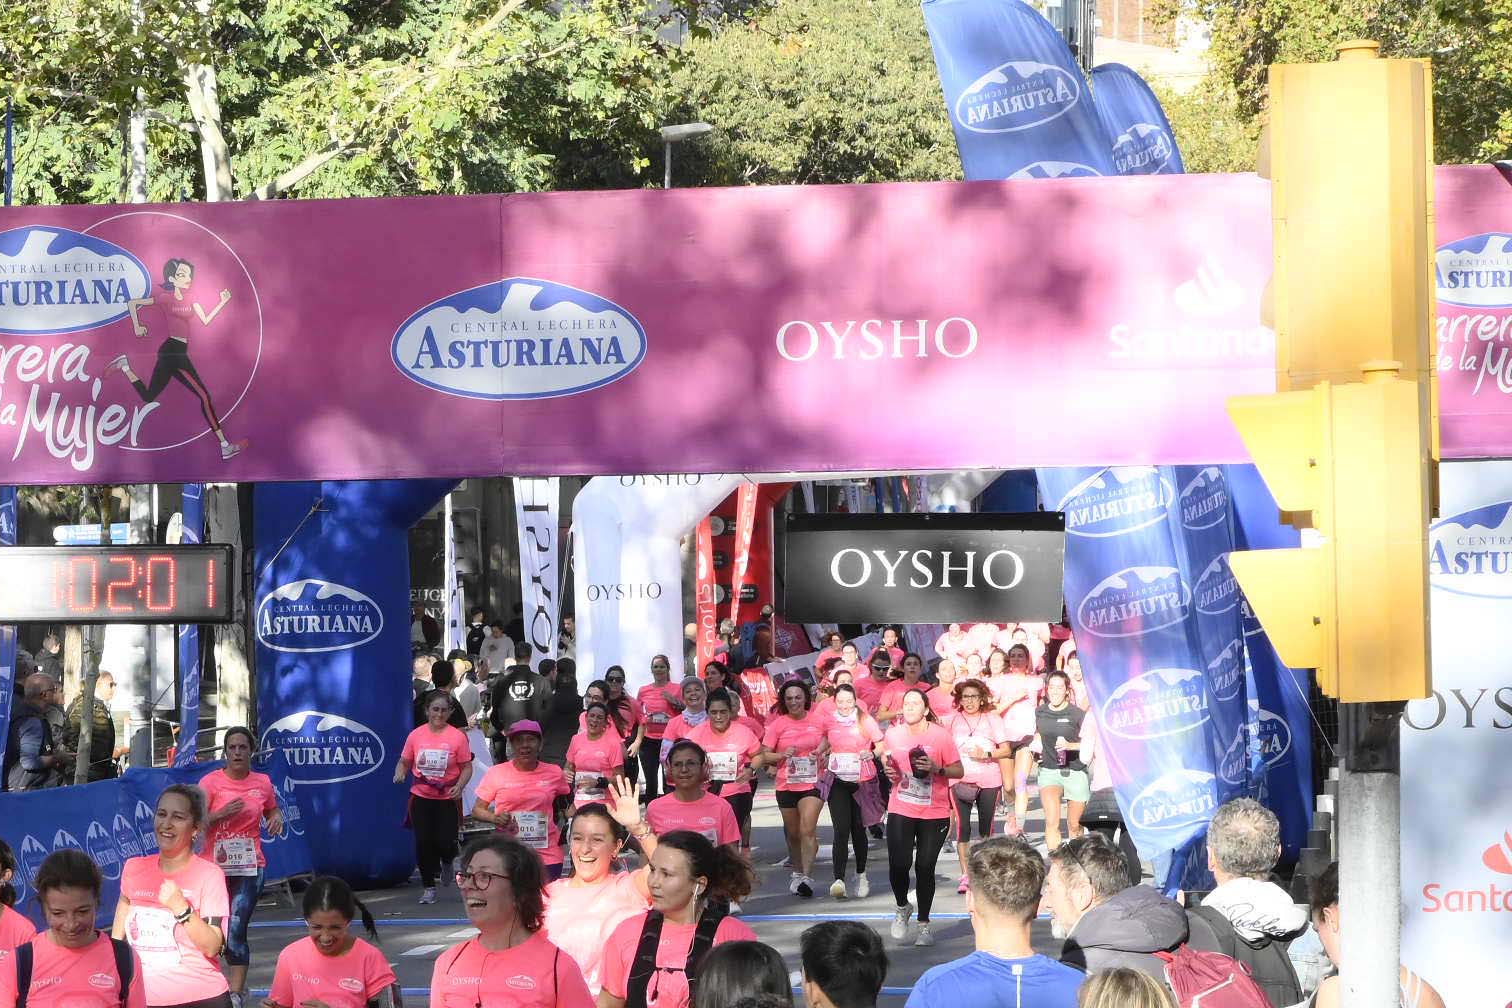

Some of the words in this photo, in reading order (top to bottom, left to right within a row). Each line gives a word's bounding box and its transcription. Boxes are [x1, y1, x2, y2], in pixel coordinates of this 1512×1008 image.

[54, 261, 127, 273] LECHERA
[451, 320, 529, 333] CENTRAL
[537, 318, 618, 331] LECHERA
[411, 325, 627, 369] ASTURIANA
[775, 316, 979, 362] OYSHO
[11, 377, 161, 471] Mujer
[830, 548, 1025, 590] OYSHO
[586, 582, 662, 602] OYSHO
[274, 605, 317, 613] CENTRAL
[321, 604, 370, 612] LECHERA
[260, 609, 375, 637] ASTURIANA
[275, 736, 318, 744] CENTRAL
[321, 735, 371, 744] LECHERA
